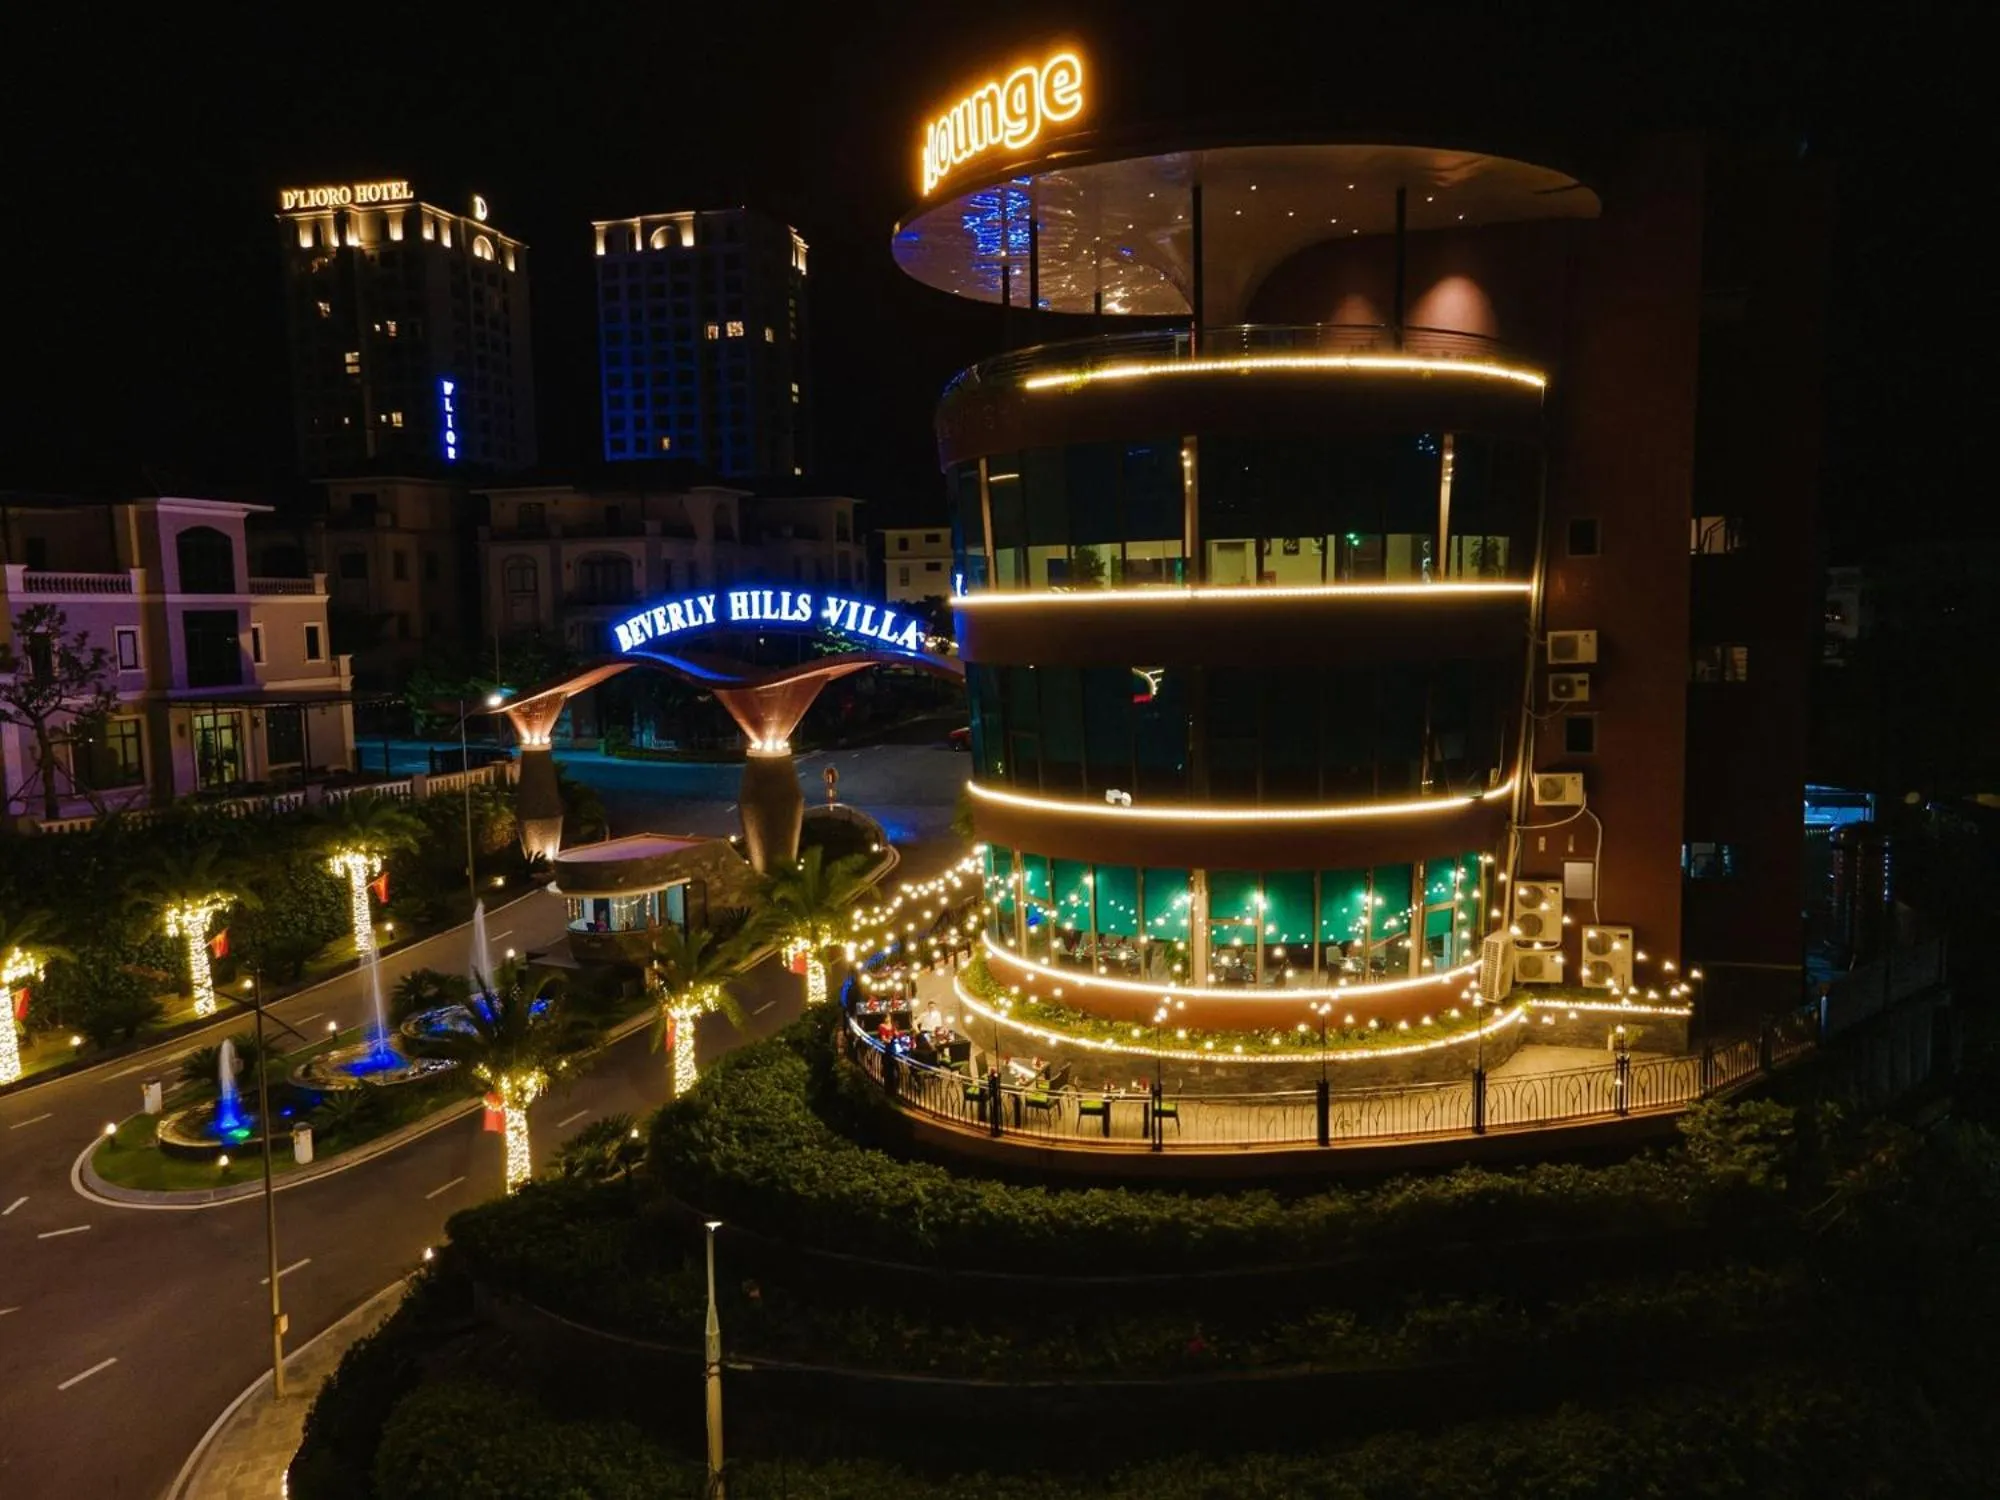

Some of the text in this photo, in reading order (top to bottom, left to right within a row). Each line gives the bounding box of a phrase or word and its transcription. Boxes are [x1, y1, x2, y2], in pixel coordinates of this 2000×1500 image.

[282, 181, 414, 209] D'LIORO HOTEL
[614, 590, 919, 652] BEVERLY HILLS VILLA
